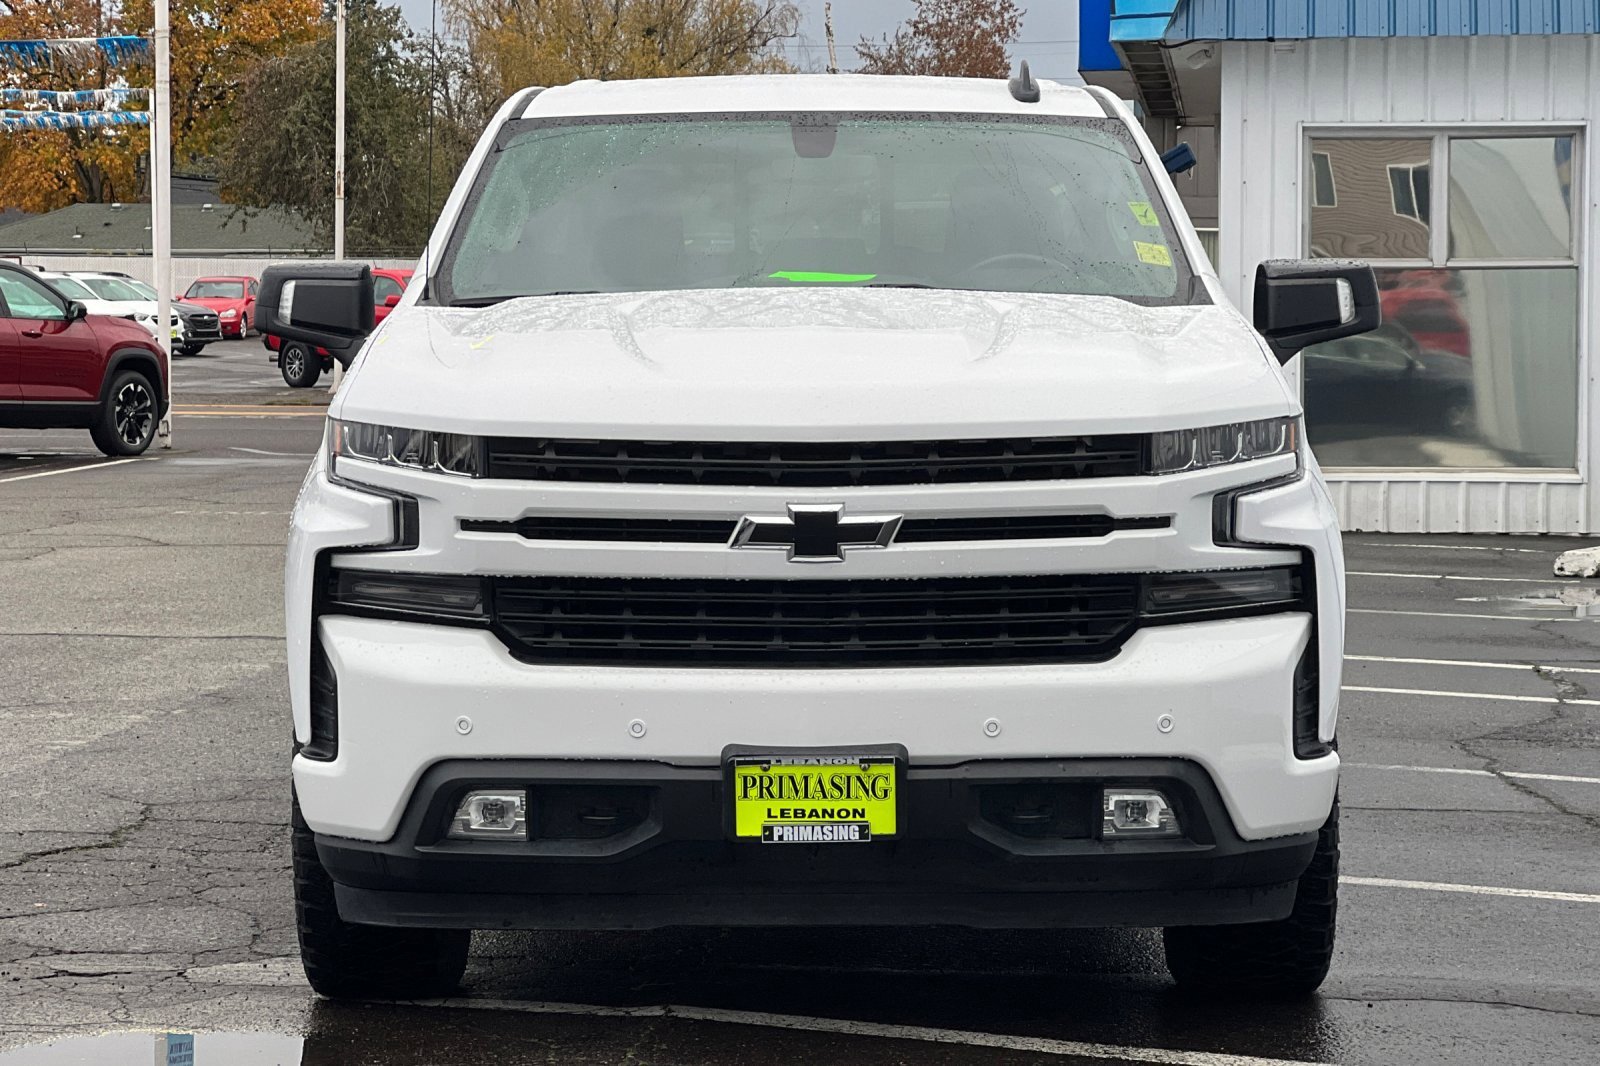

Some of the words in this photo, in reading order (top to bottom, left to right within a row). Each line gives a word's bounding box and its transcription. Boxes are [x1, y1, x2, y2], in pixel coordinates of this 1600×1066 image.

[738, 773, 892, 801] PRIMASING
[767, 808, 865, 818] LEBANON
[773, 826, 859, 841] PRIMASING
